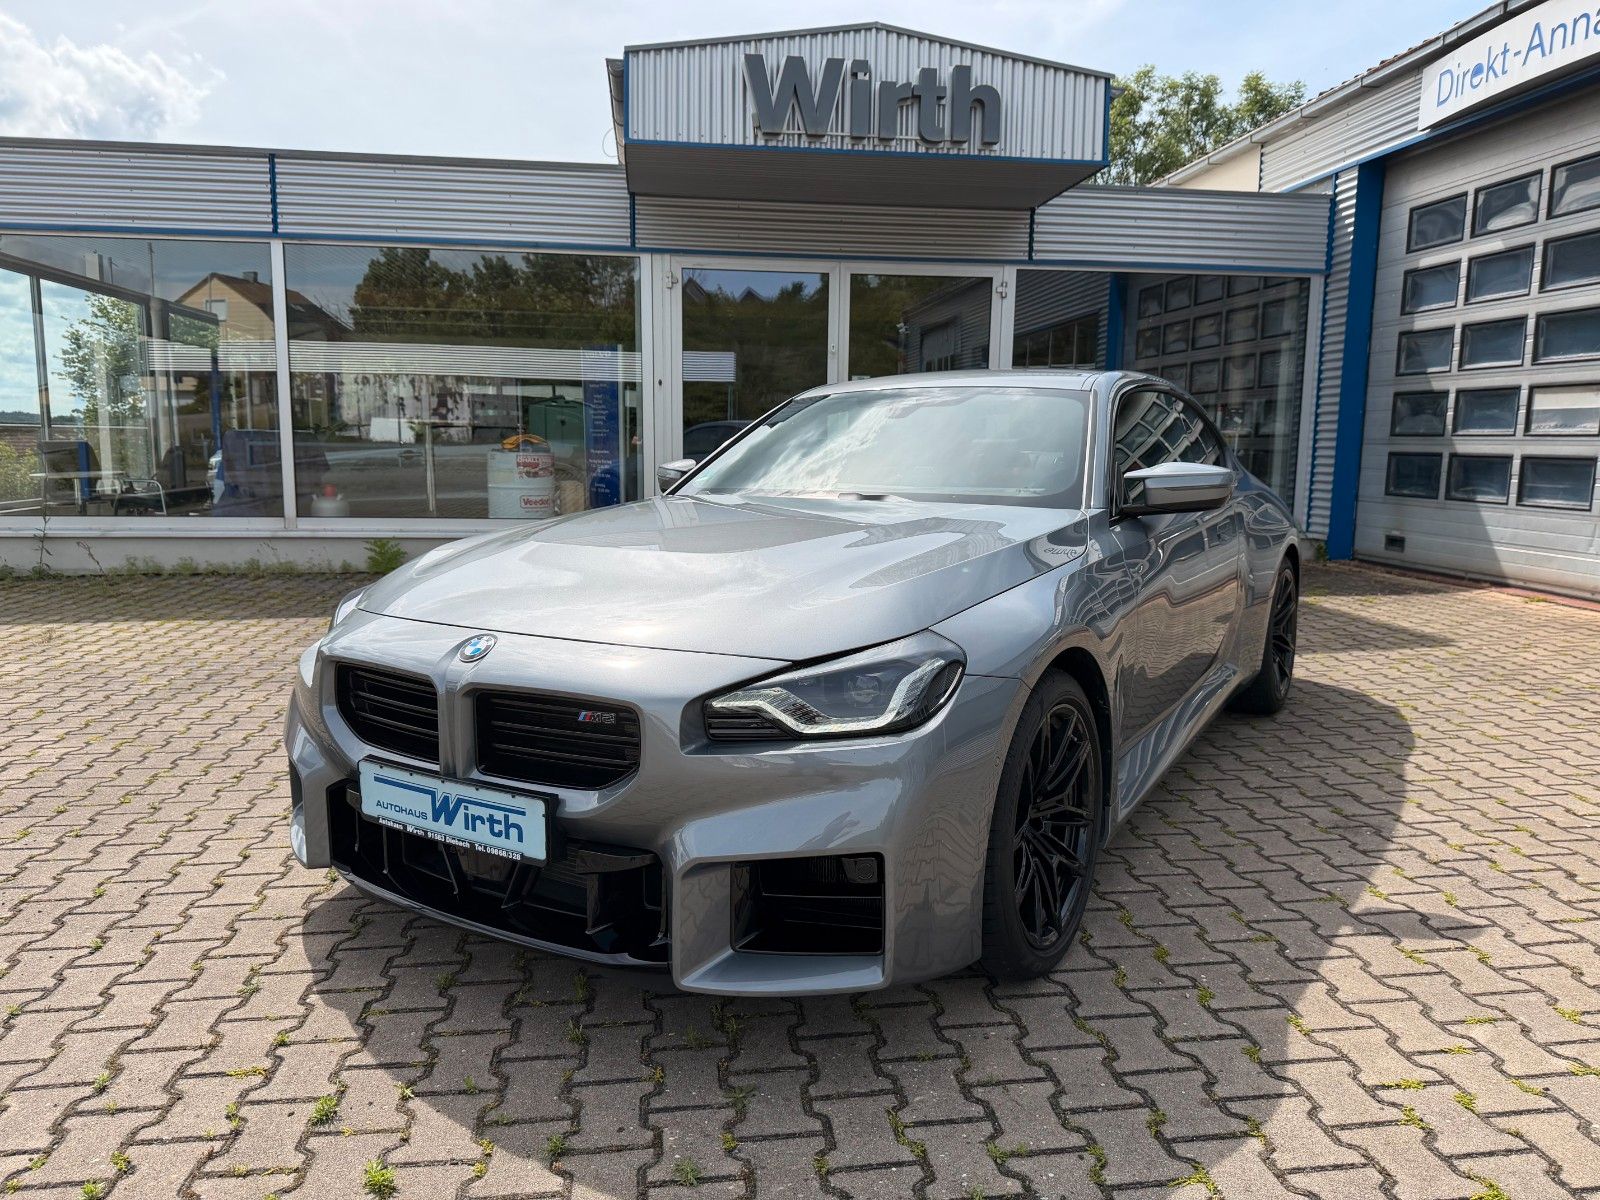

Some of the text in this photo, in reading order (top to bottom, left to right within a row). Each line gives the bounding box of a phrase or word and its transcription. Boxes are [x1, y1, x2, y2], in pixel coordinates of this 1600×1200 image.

[743, 53, 1000, 146] Wirth
[590, 711, 616, 724] M2
[375, 793, 524, 843] AUTOHAUS Wirth
[378, 817, 404, 830] Autohaus
[406, 824, 425, 836] Wirth
[427, 831, 445, 842] 91583
[445, 836, 470, 848] Diebach
[474, 843, 486, 852] Tel.
